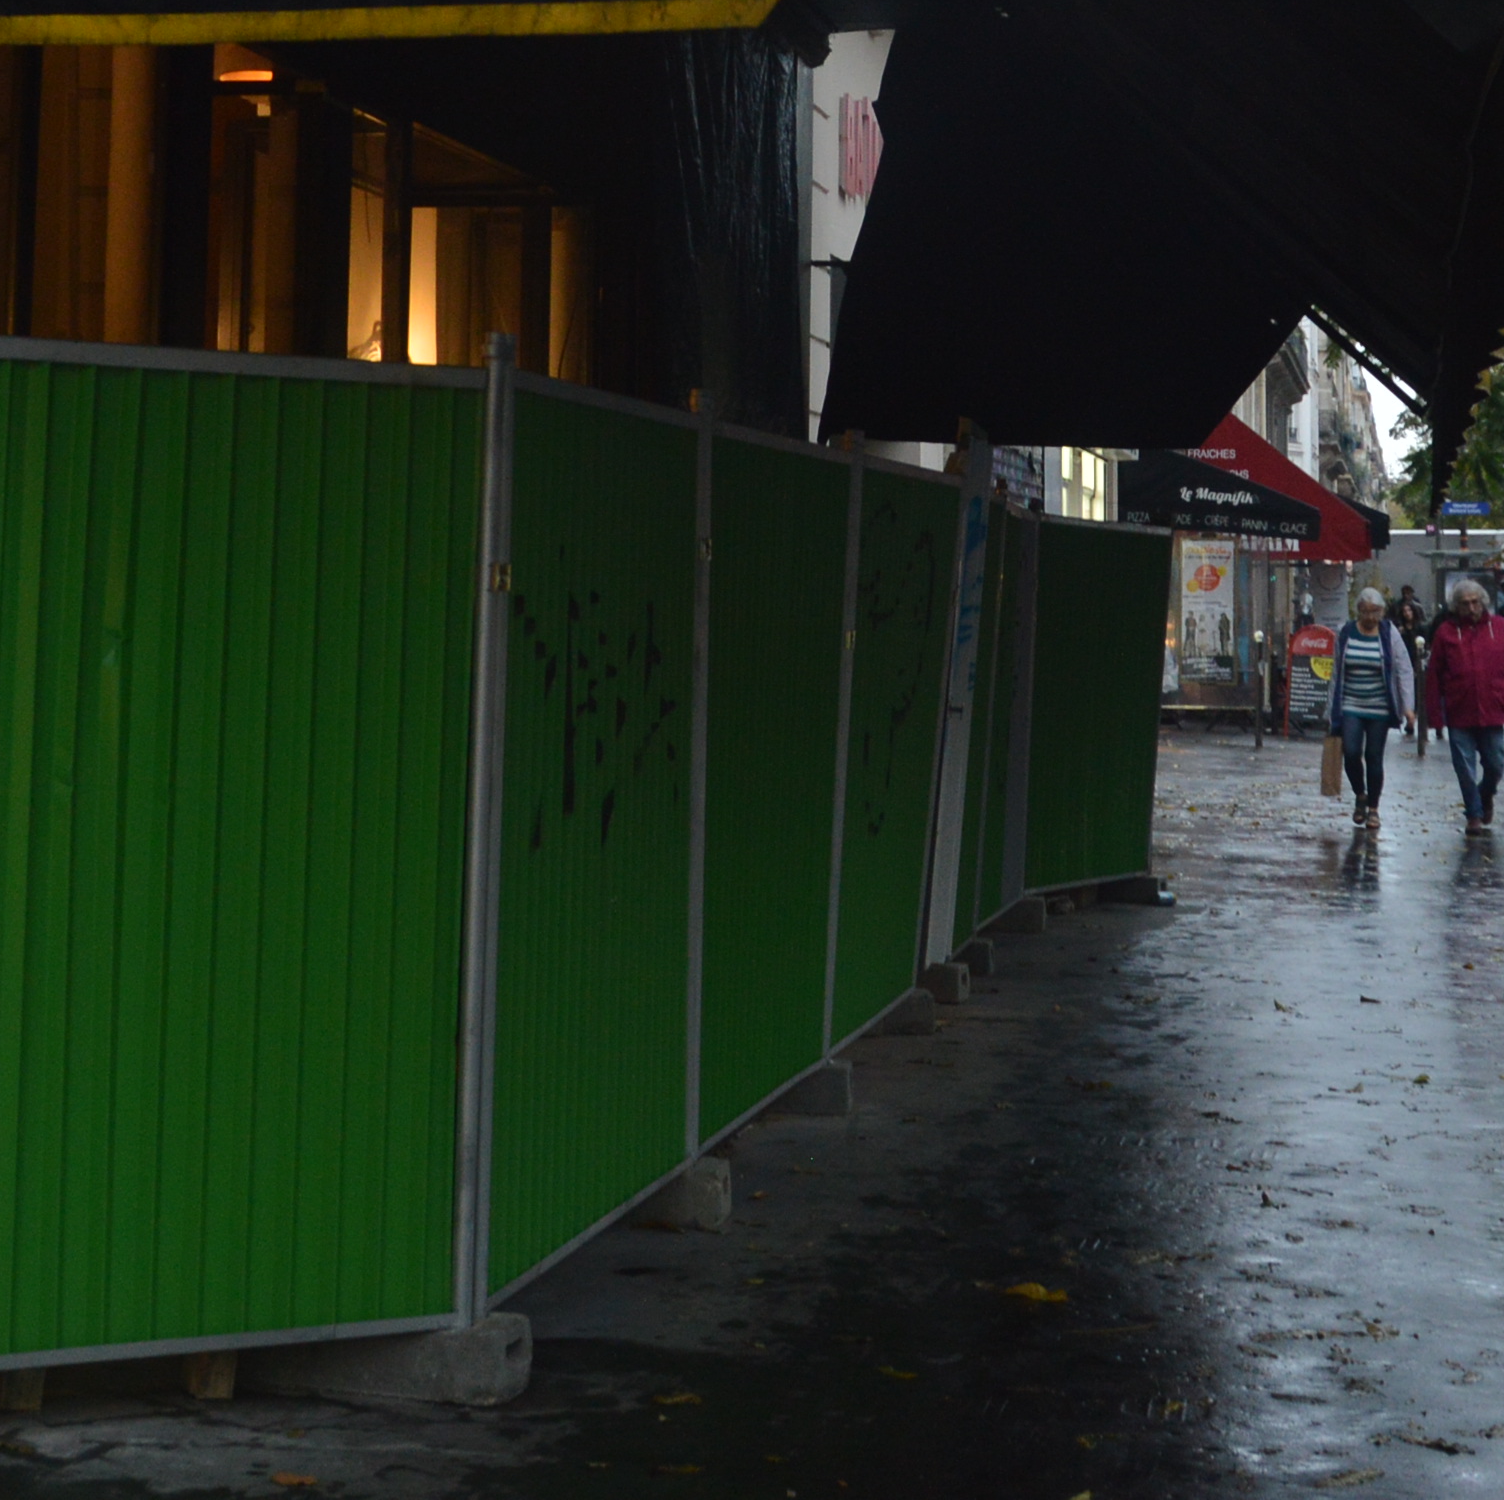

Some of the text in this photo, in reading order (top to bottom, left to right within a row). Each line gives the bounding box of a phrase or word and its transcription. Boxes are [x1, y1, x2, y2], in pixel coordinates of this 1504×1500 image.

[1180, 486, 1193, 503] Le
[1127, 511, 1151, 523] PIZZA
[1280, 521, 1309, 535] GLACE
